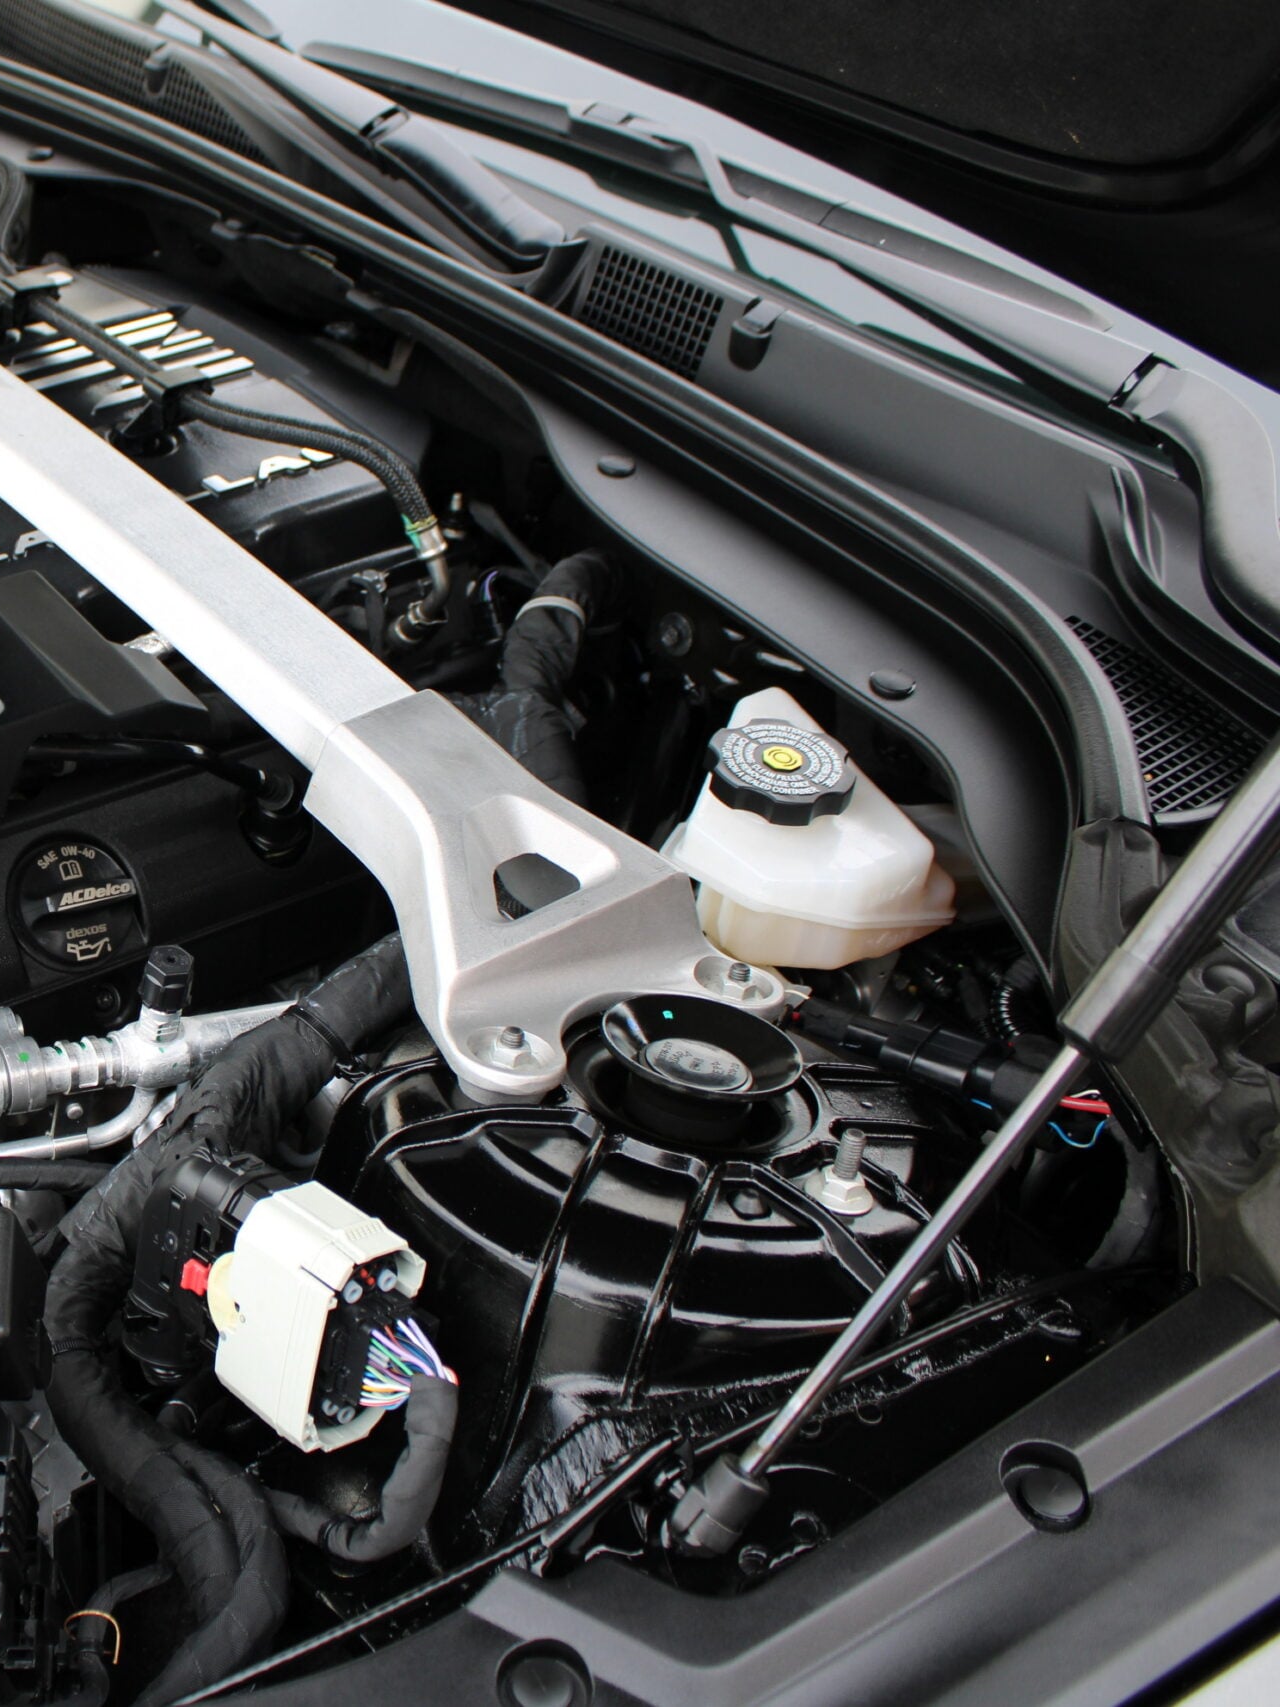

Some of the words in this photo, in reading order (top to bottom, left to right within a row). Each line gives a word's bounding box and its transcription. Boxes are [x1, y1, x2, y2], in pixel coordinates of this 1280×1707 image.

[37, 850, 58, 869] SAE
[61, 846, 96, 859] 0W-40
[59, 882, 131, 906] ACDelco
[66, 923, 108, 940] dexos
